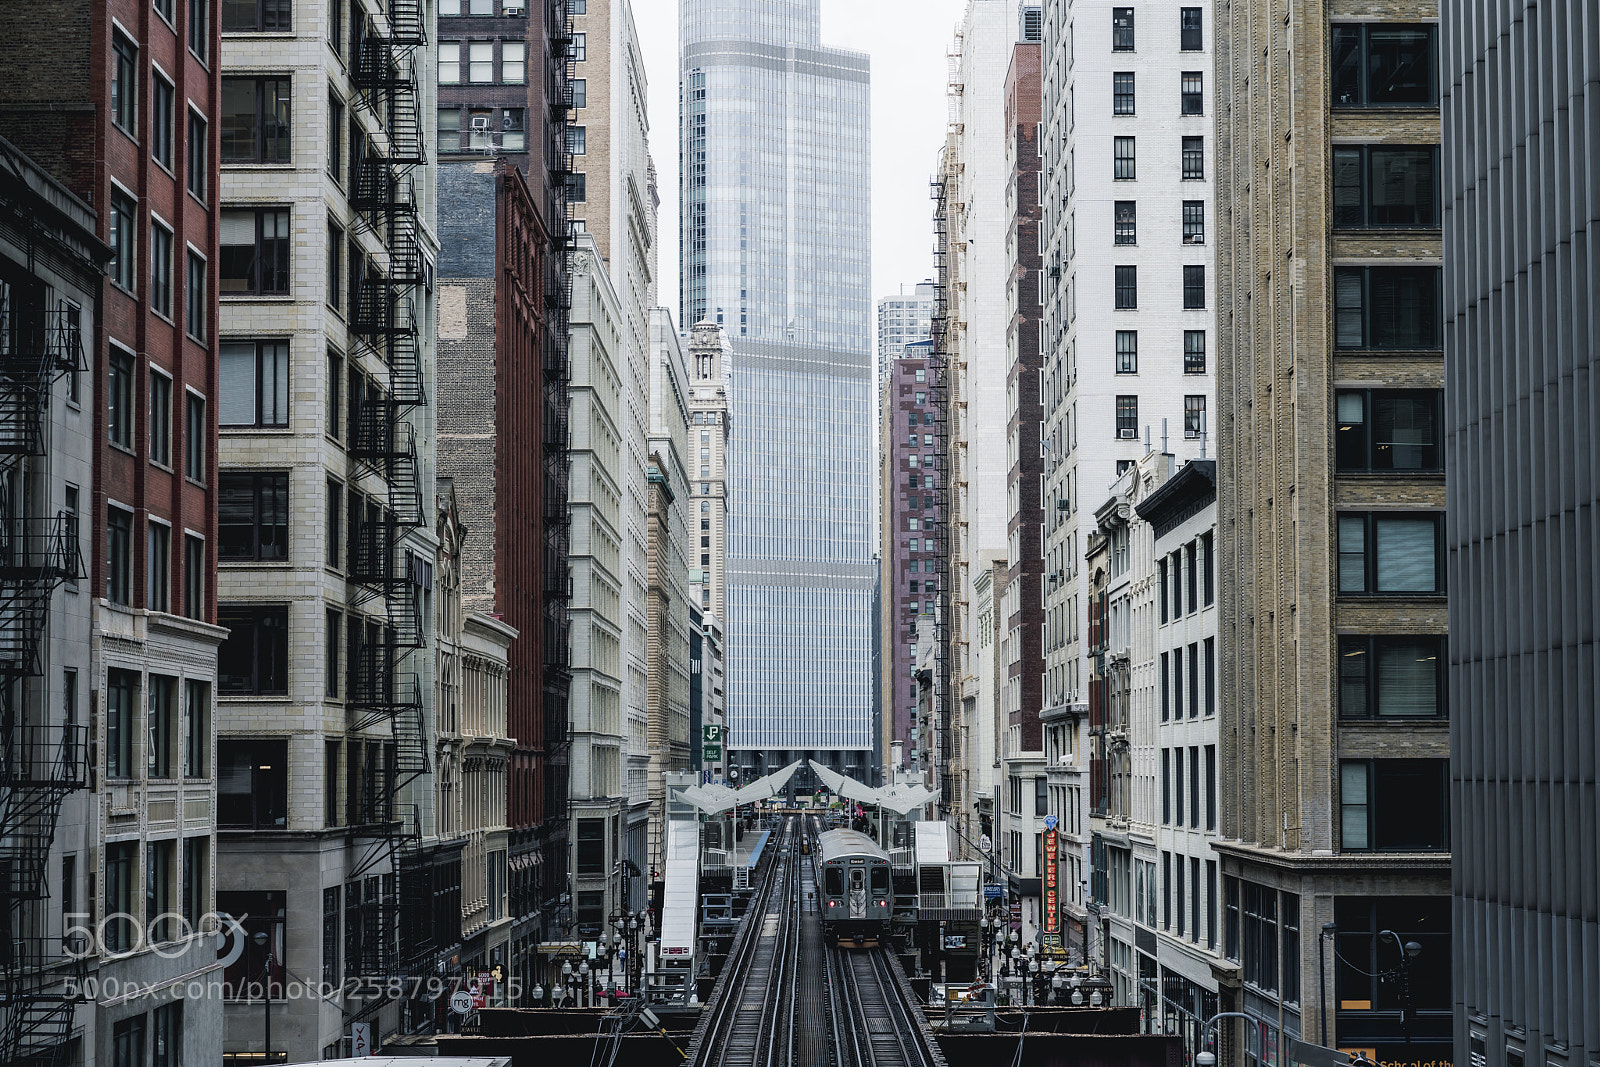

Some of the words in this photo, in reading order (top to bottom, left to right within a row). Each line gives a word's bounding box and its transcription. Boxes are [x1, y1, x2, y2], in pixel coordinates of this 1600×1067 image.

[1045, 831, 1057, 888] JEWELERS
[1046, 889, 1057, 932] CENTER
[453, 999, 470, 1009] mg
